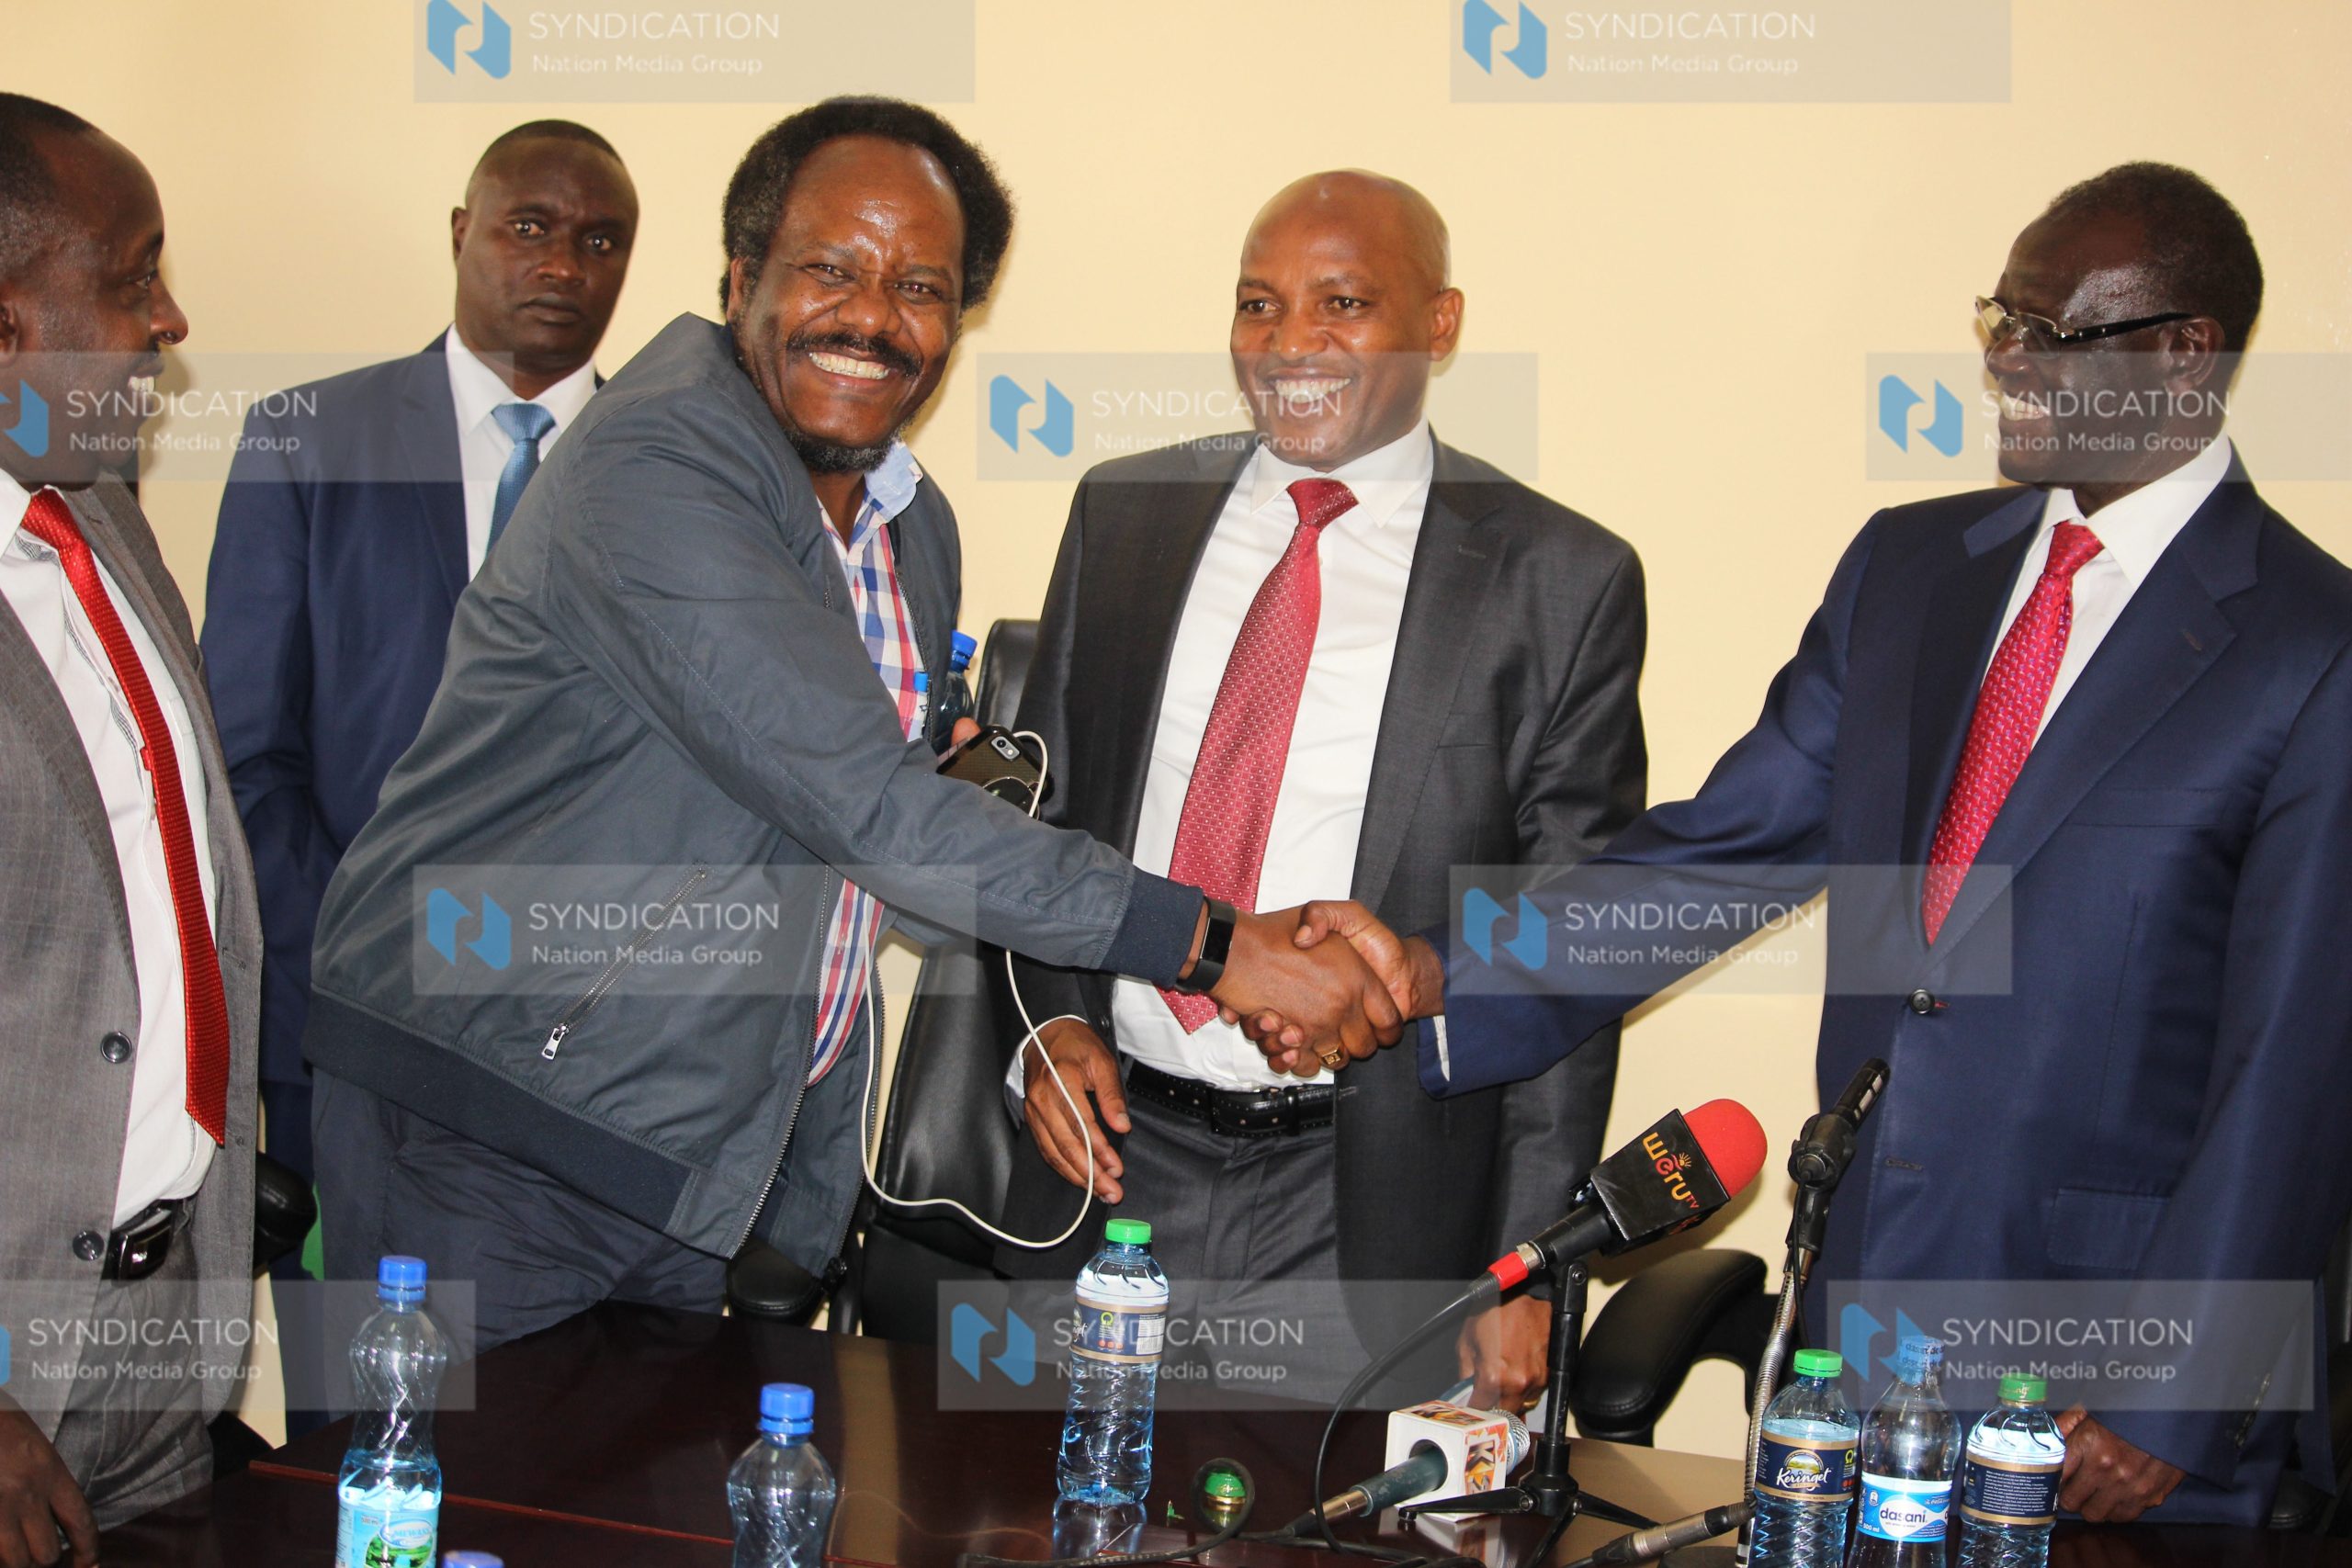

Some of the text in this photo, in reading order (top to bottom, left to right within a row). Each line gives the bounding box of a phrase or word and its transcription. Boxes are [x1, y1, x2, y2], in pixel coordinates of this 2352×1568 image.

[1685, 1194, 1700, 1210] TV
[1776, 1467, 1832, 1492] Keringet
[1880, 1507, 1927, 1523] dasani
